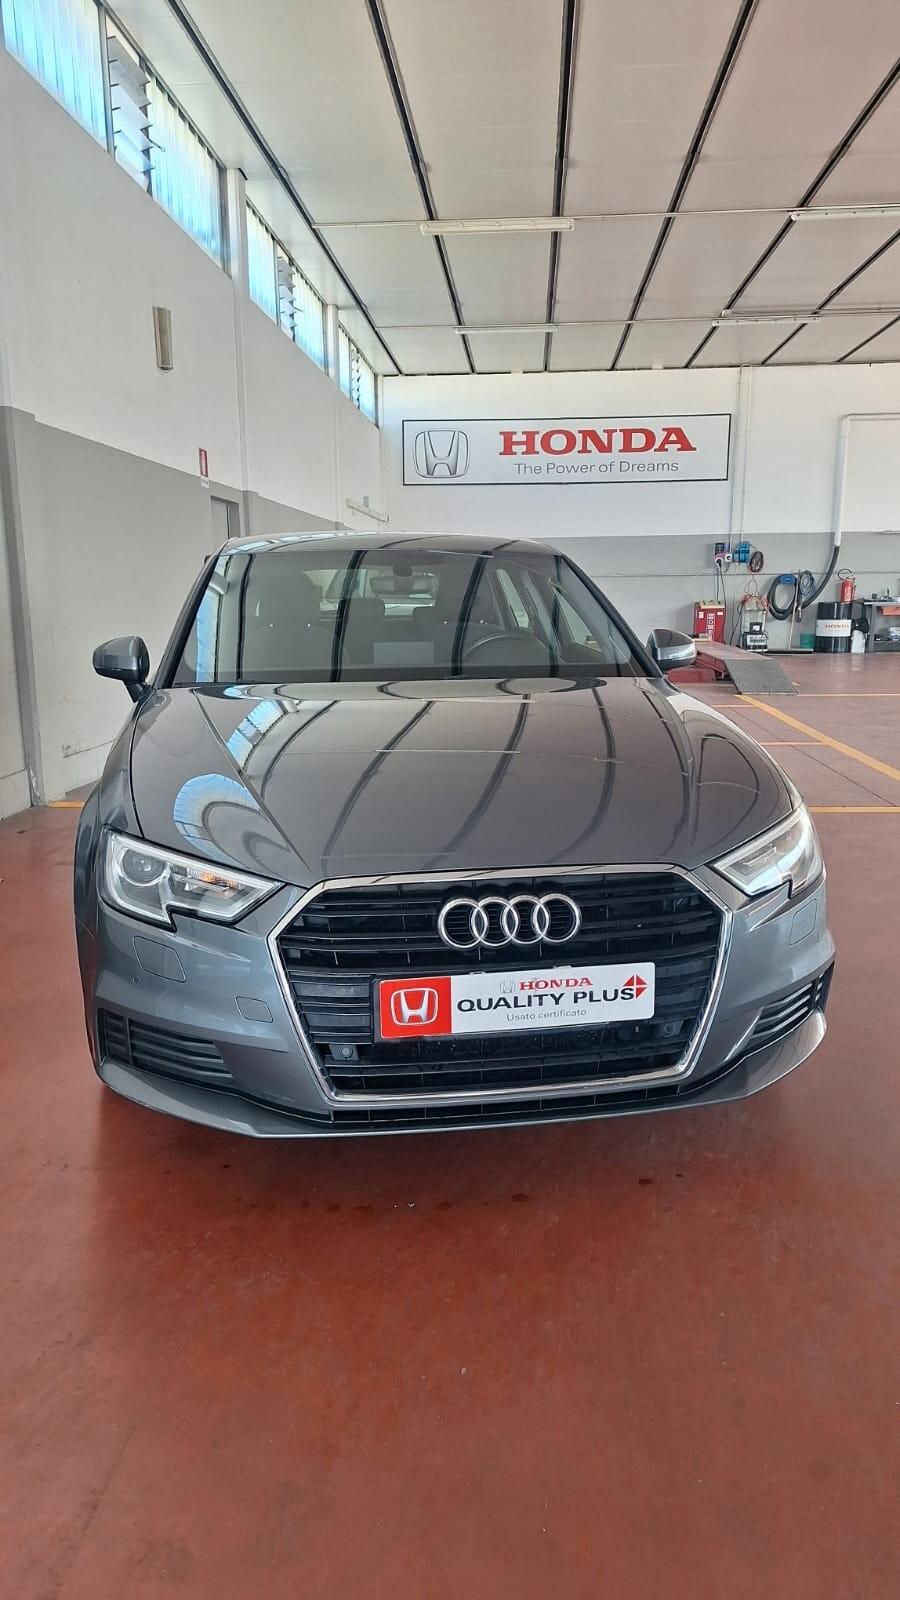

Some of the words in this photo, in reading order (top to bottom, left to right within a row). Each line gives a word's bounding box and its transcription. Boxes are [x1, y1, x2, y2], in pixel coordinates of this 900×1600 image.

[499, 427, 696, 455] HONDA
[514, 463, 542, 474] The
[546, 462, 595, 474] Power
[598, 461, 615, 473] of
[619, 461, 679, 473] Dreams
[519, 977, 593, 990] HONDA
[457, 993, 565, 1012] QUALITY
[573, 987, 635, 1004] PLUS
[506, 1012, 535, 1021] Usato
[538, 1009, 587, 1019] certificato
